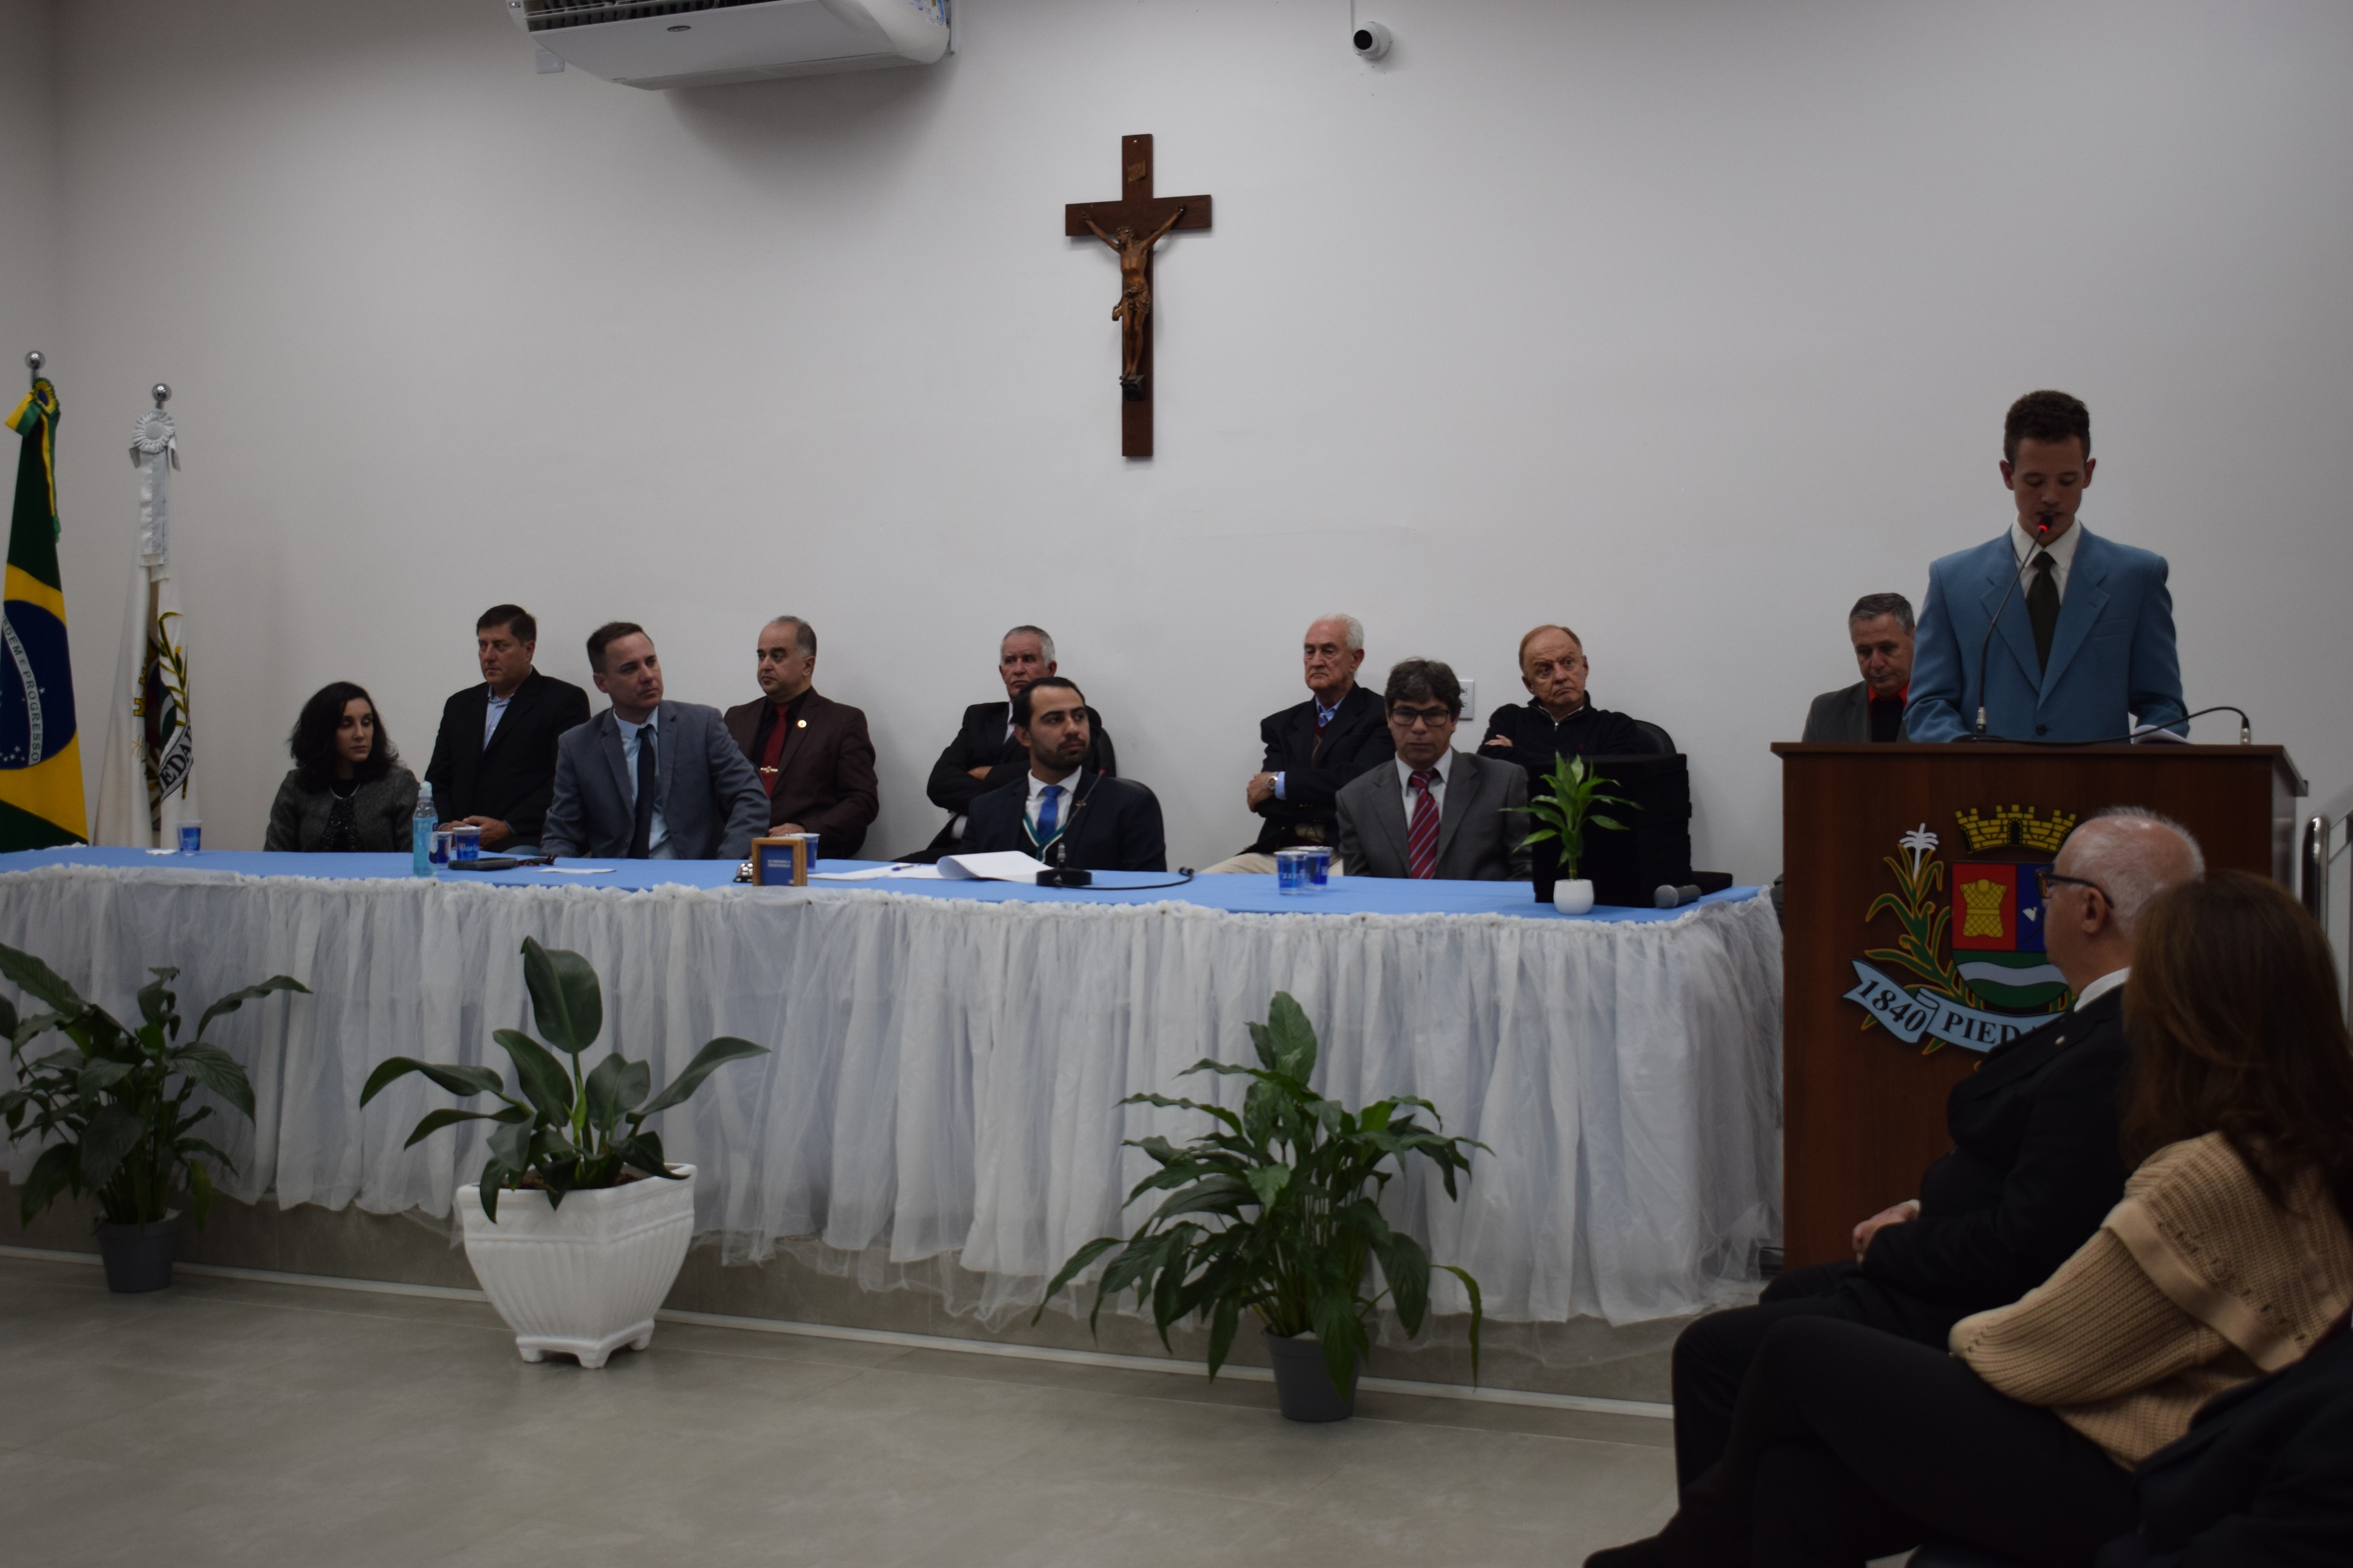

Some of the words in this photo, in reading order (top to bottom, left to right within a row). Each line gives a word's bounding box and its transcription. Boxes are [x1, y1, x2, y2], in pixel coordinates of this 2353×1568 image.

[2, 615, 22, 656] RDEM
[23, 671, 41, 761] PROGRESSO
[1857, 979, 1926, 1032] 1840
[1940, 1011, 2037, 1044] PIED
